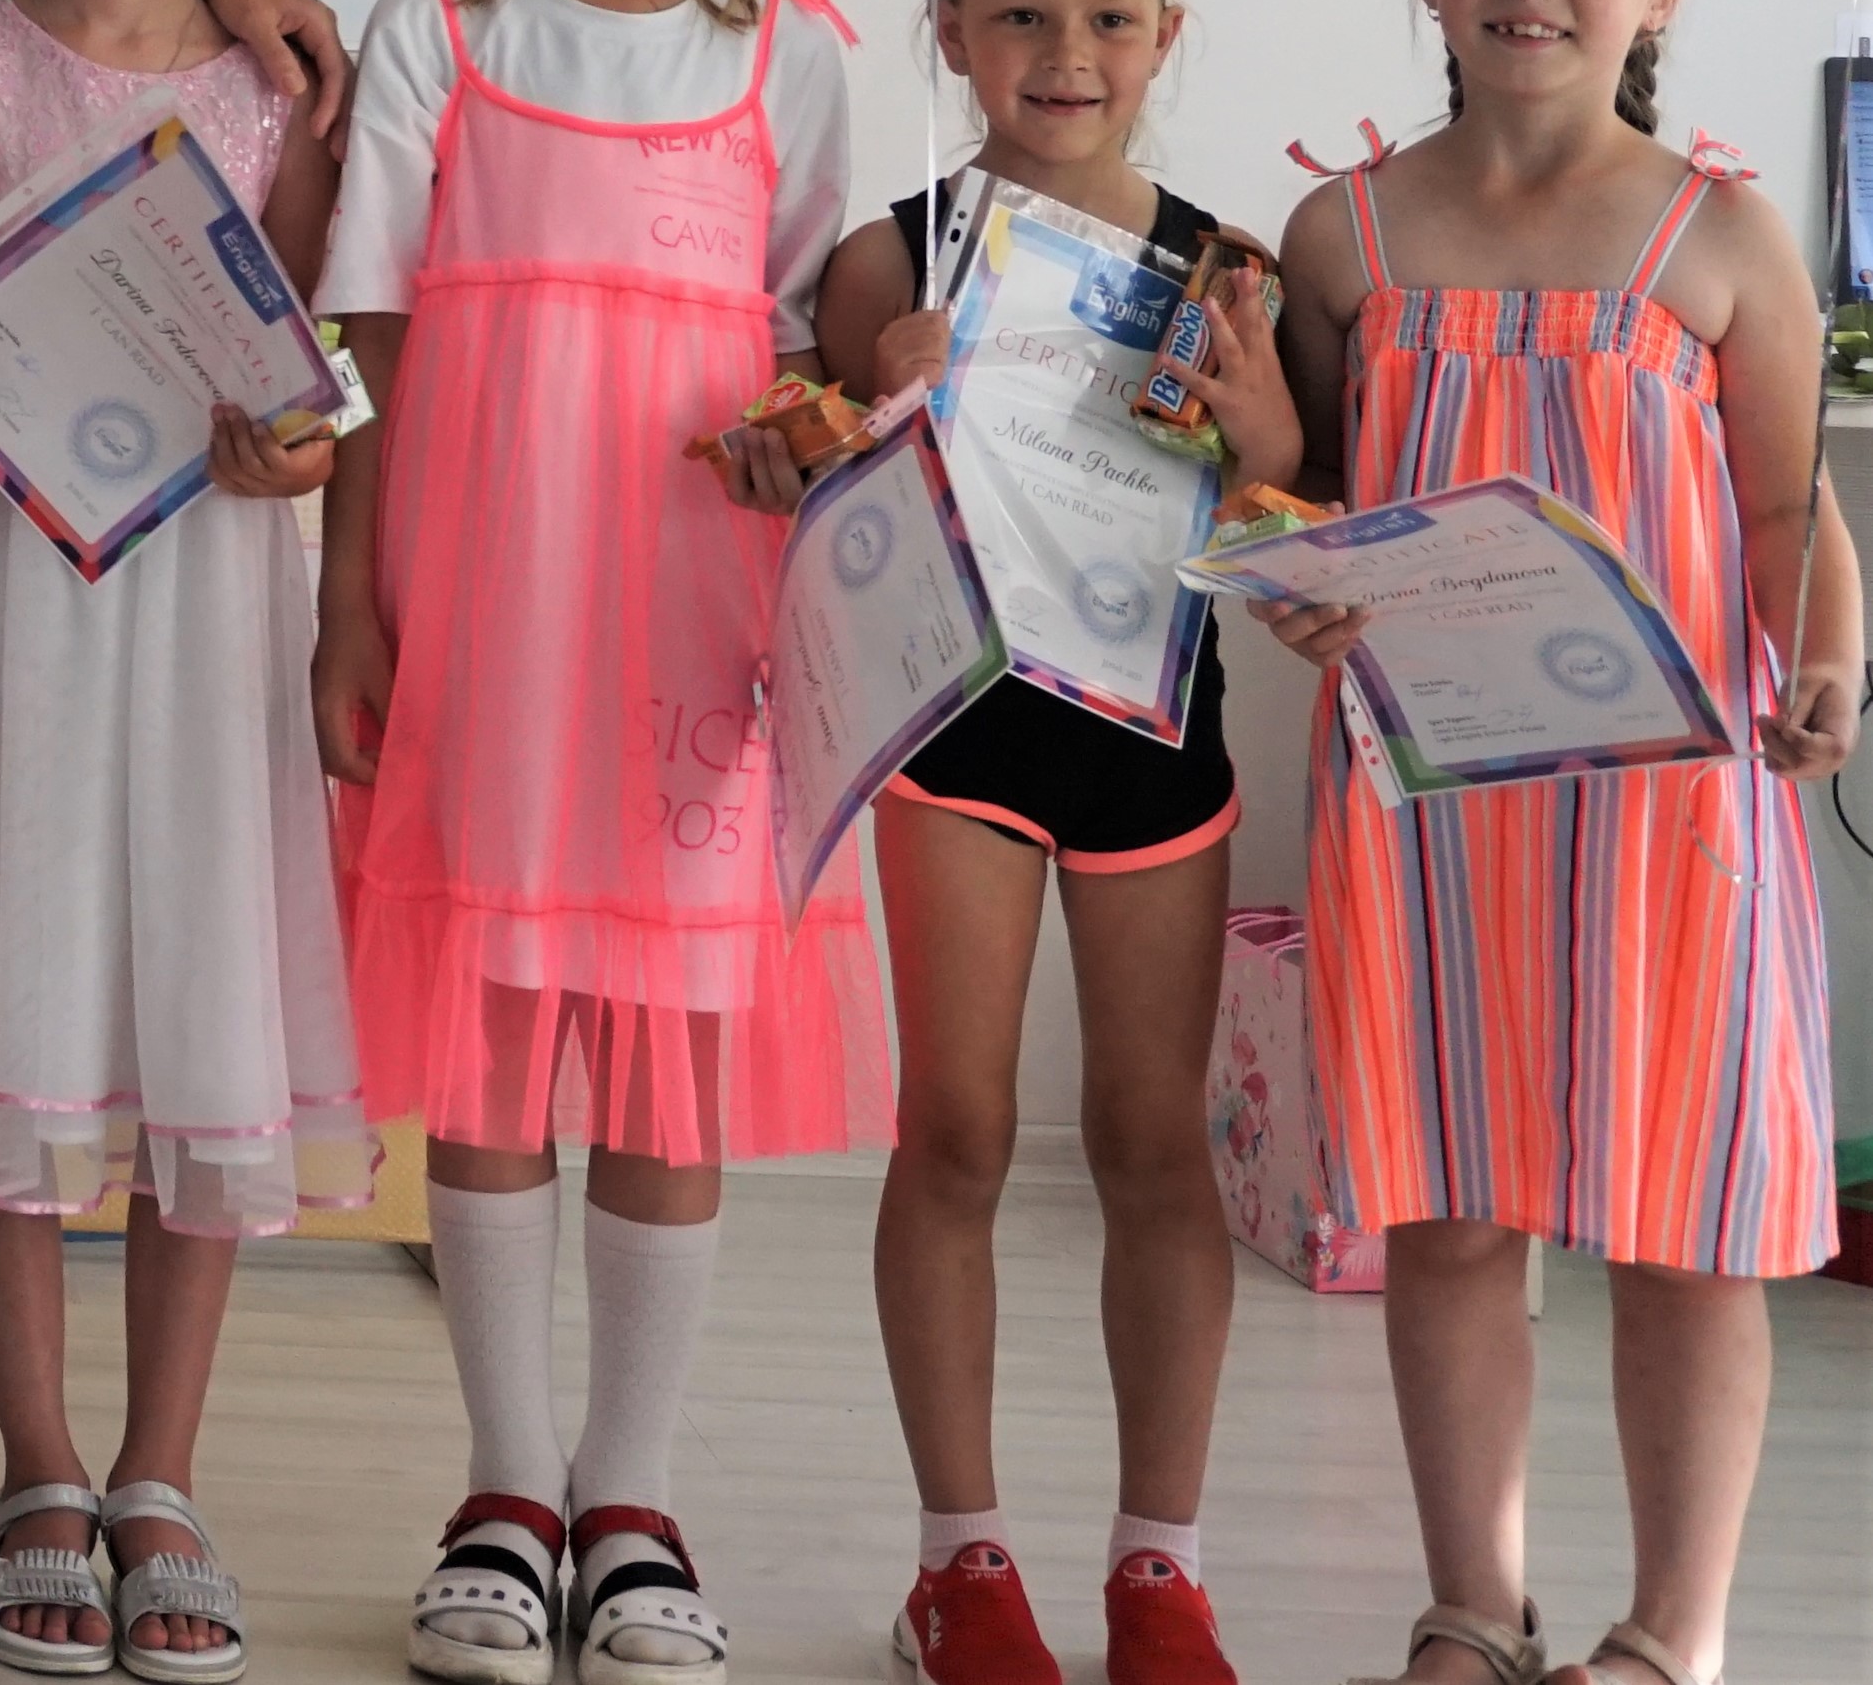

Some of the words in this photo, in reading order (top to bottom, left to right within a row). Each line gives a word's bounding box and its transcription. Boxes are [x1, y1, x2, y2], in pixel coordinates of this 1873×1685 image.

[220, 232, 274, 311] English
[90, 247, 154, 318] Darina
[153, 318, 225, 403] Fedorova
[1087, 286, 1162, 333] English
[995, 328, 1142, 404] CERTIFIC
[993, 416, 1073, 464] Milana
[1080, 450, 1160, 497] Pachko
[1032, 483, 1068, 509] CAN
[1072, 500, 1114, 527] READ
[1324, 515, 1416, 547] English
[1430, 564, 1558, 595] Bogdanova
[1483, 601, 1535, 616] READ
